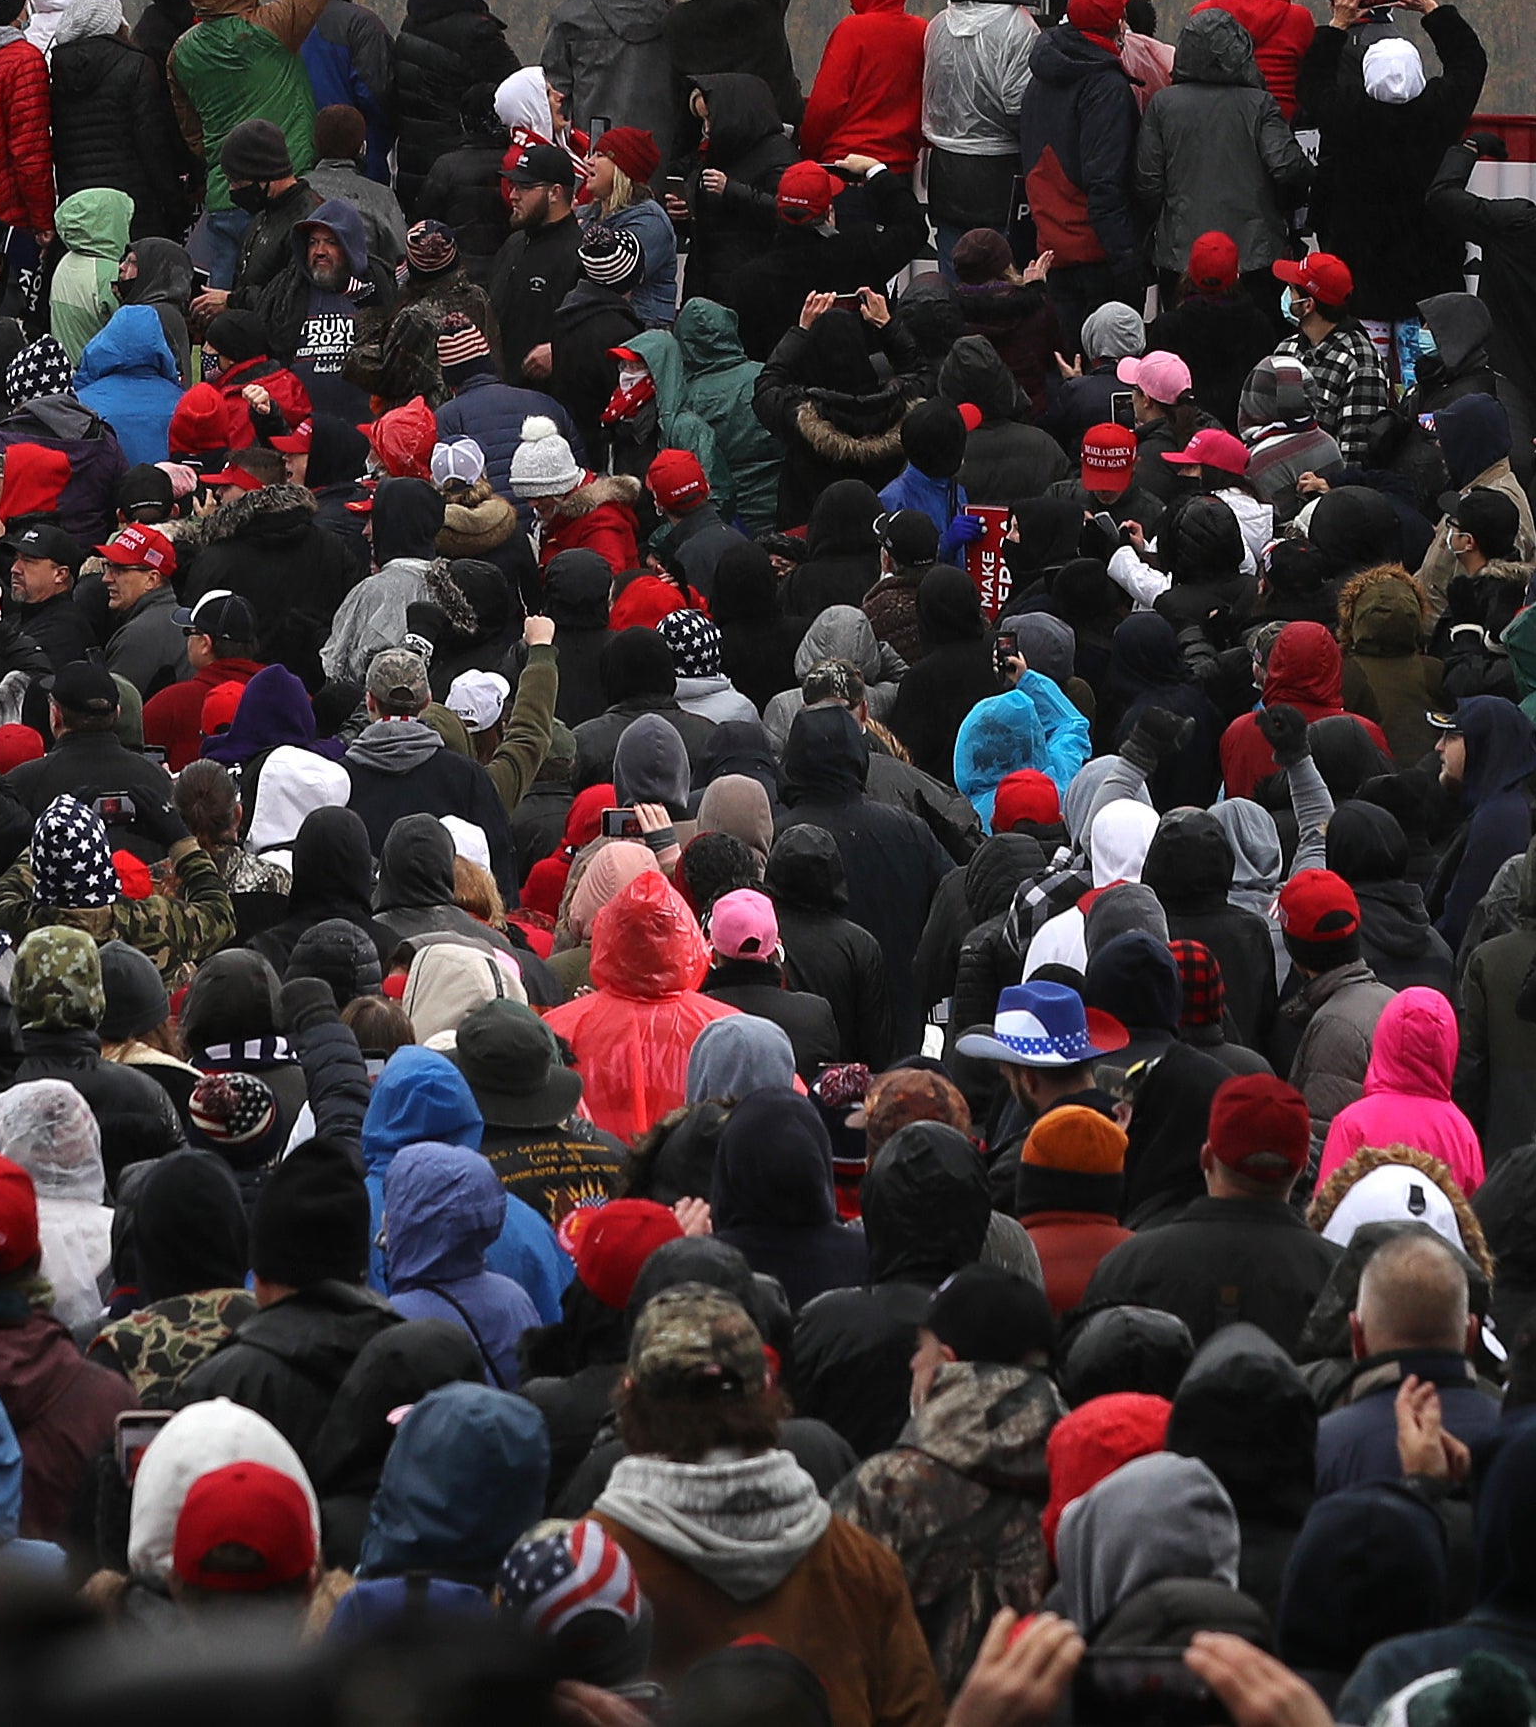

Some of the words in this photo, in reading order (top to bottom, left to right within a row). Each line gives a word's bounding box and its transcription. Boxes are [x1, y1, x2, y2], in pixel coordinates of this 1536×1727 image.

[300, 318, 354, 335] TRUM
[1084, 444, 1101, 455] MAKE
[1102, 445, 1131, 456] AMERICA
[1086, 457, 1106, 467] GREAT
[1107, 458, 1127, 467] AGAIN
[980, 551, 995, 608] MAKE
